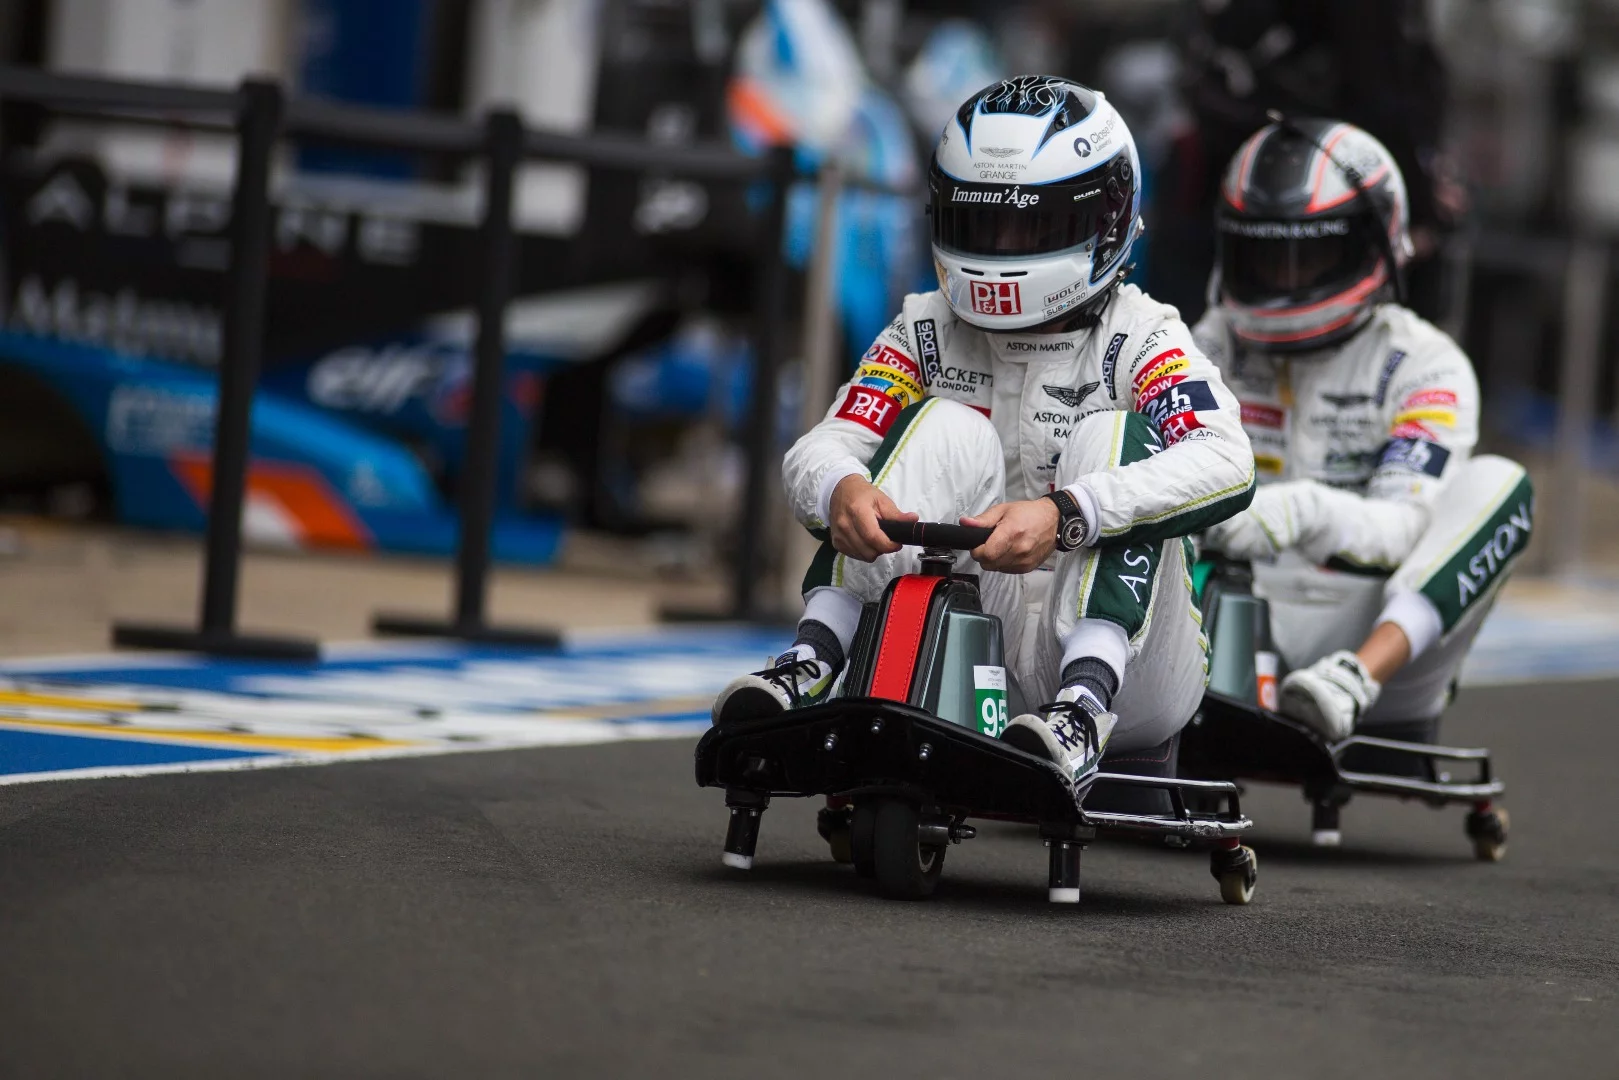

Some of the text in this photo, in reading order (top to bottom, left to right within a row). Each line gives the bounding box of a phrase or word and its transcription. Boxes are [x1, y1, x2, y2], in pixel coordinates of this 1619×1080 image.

[980, 171, 1017, 180] GRANGE
[997, 162, 1027, 170] MARTIN
[1073, 188, 1102, 201] DURA
[26, 173, 420, 266] ALPNE
[1290, 219, 1349, 239] RACING
[973, 281, 1022, 316] P&H
[1047, 281, 1081, 304] WOLF
[1006, 341, 1075, 351] ASTON MARTIN
[1129, 342, 1158, 374] LONDON
[869, 369, 920, 395] DUNLOP
[937, 366, 993, 387] ACKETT
[937, 380, 976, 393] LONDON
[1139, 377, 1173, 405] DOW
[846, 392, 892, 427] P&H
[1033, 412, 1069, 425] ASTON
[1160, 404, 1192, 424] MANS
[1456, 501, 1532, 606] ASTON
[1117, 543, 1153, 603] AS
[981, 697, 1008, 738] 95
